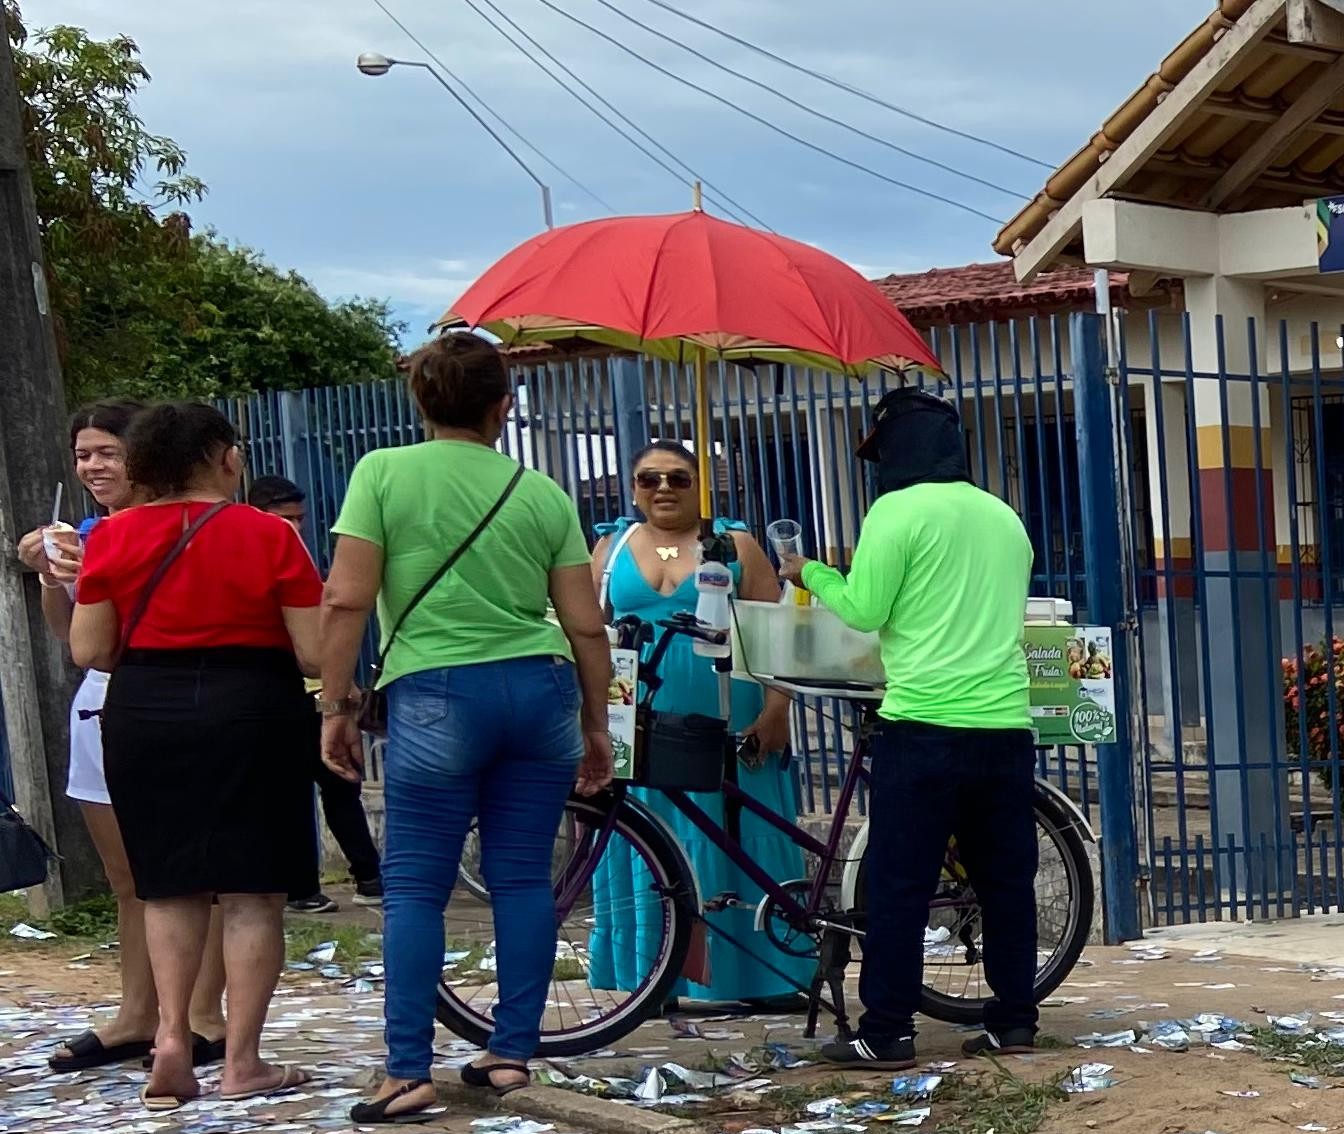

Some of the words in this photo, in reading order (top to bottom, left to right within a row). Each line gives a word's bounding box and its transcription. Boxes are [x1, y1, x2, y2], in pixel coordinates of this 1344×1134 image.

[1024, 642, 1061, 661] Salada
[1075, 709, 1100, 722] 100%
[1076, 721, 1104, 733] Natural
